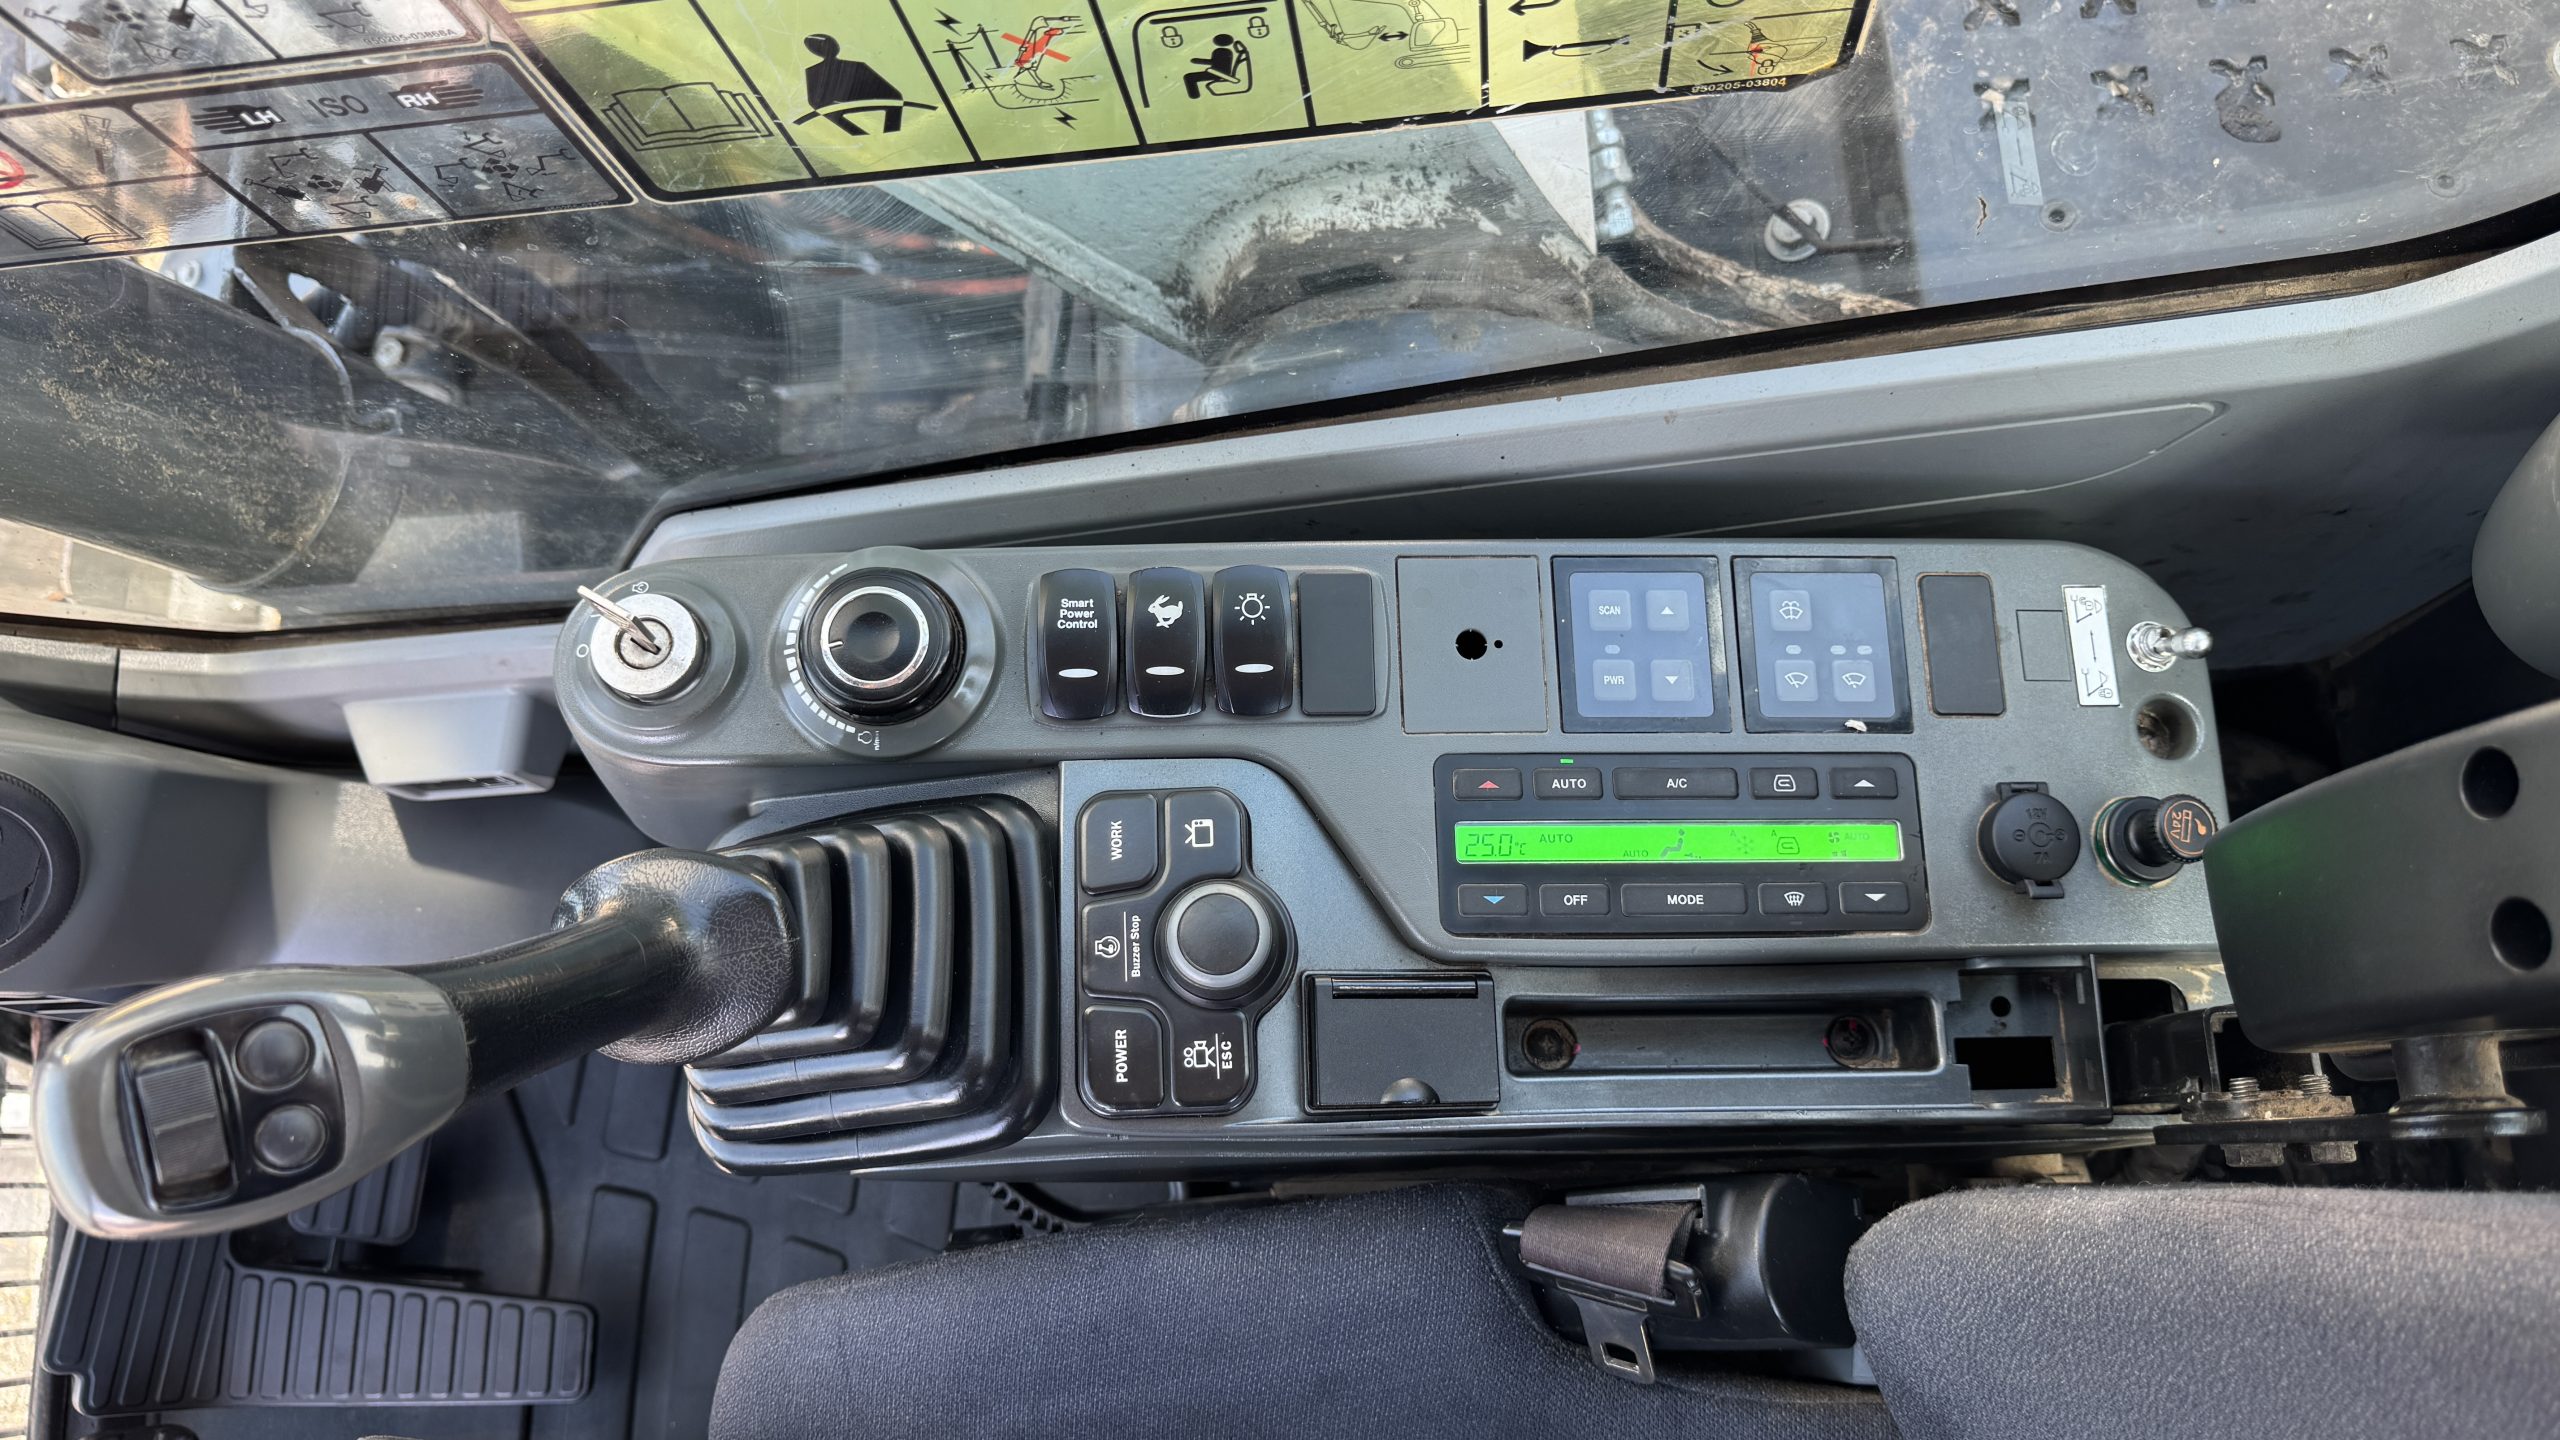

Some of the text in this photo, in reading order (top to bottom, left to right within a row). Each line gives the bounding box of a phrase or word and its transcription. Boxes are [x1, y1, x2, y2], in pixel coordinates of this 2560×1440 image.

[1691, 77, 1787, 93] 950205-03804
[397, 92, 440, 108] RH
[307, 94, 369, 118] ISO
[240, 109, 281, 126] LH
[1061, 598, 1094, 609] Smart
[1060, 609, 1094, 619] Power
[1598, 605, 1621, 616] SCAN
[1057, 619, 1098, 630] Control
[1603, 675, 1625, 686] PWR
[1551, 778, 1587, 789] AUTO
[1666, 778, 1688, 789] A/C
[2169, 811, 2182, 839] 24V
[1111, 820, 1123, 860] WORK
[1539, 833, 1573, 844] AUTO
[1844, 832, 1870, 841] AUTO
[1622, 849, 1648, 857] AUTO
[1563, 894, 1588, 906] OFF
[1667, 894, 1704, 905] MODE
[1130, 914, 1142, 978] Buzzer Stop
[1115, 1029, 1129, 1083] POWER
[1221, 1040, 1233, 1069] ESC
